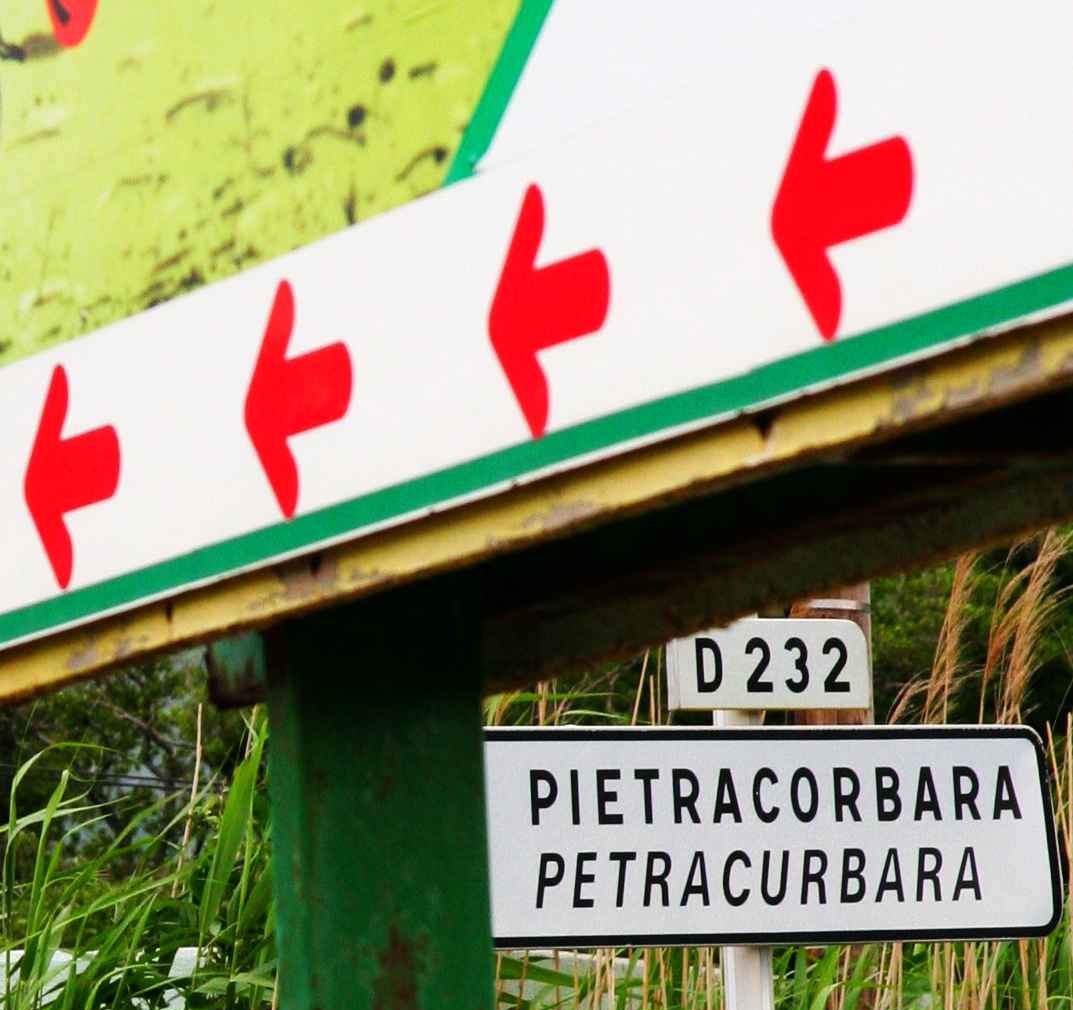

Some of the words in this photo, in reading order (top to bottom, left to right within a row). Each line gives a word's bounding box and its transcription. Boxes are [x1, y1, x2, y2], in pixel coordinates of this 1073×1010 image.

[695, 638, 723, 693] D
[745, 637, 850, 693] 232
[530, 765, 1023, 825] PIETRACORBARA
[536, 846, 982, 909] PETRACURBARA
